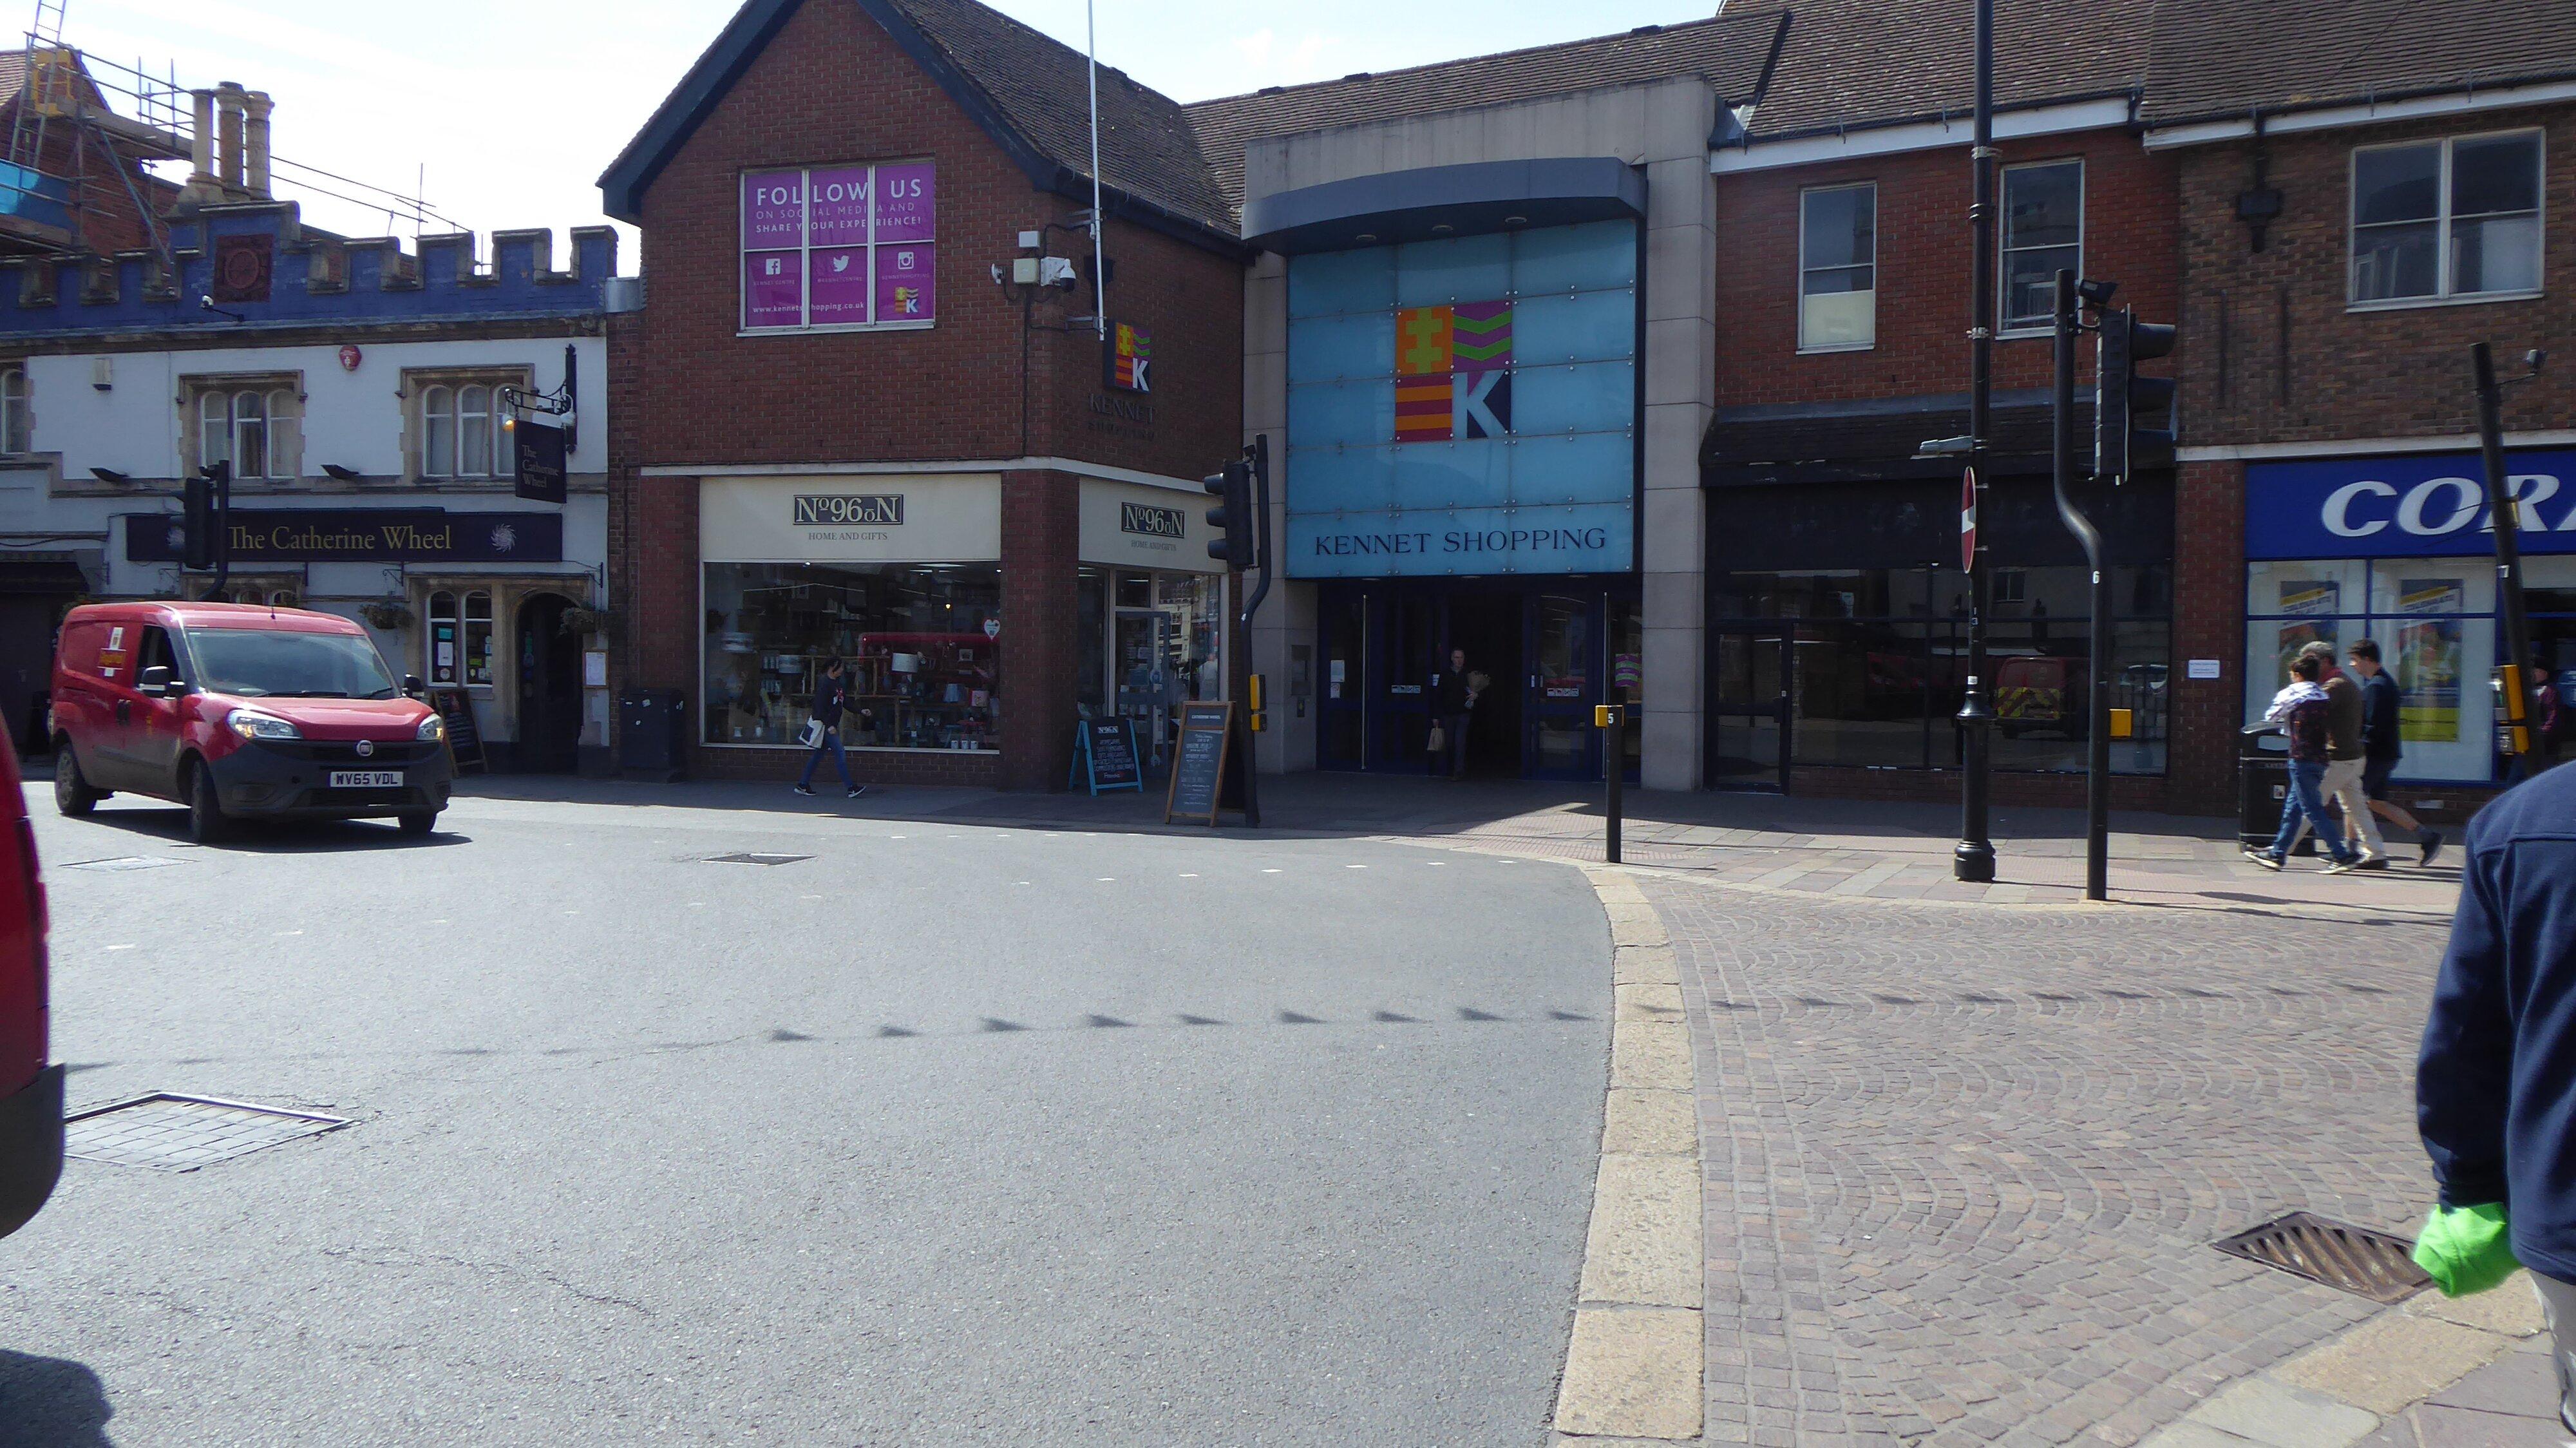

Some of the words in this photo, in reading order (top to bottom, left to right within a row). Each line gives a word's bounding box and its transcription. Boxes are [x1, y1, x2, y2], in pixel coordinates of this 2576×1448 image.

[757, 182, 868, 205] FOLLOW
[890, 178, 922, 198] US
[756, 210, 775, 220] ON
[780, 207, 831, 219] SOCIAL
[837, 205, 883, 216] MEDIA
[889, 202, 914, 213] AND
[756, 225, 791, 233] SHARE
[797, 221, 834, 231] YOUR
[840, 216, 922, 229] EXPERIENCE!
[522, 444, 536, 458] The
[522, 459, 560, 477] Catherine
[522, 473, 547, 488] Wheel
[2321, 474, 2576, 537] COR
[228, 526, 265, 550] The
[271, 526, 375, 550] Catherine
[381, 526, 452, 550] Wheel
[809, 532, 837, 540] HOME
[839, 532, 860, 540] AND
[861, 532, 888, 540] GIFTS
[1315, 533, 1432, 556] KENNET
[1443, 527, 1607, 553] SHOPPING
[1608, 712, 1614, 724] 5
[336, 774, 370, 785] WV65
[374, 773, 398, 785] VDL
